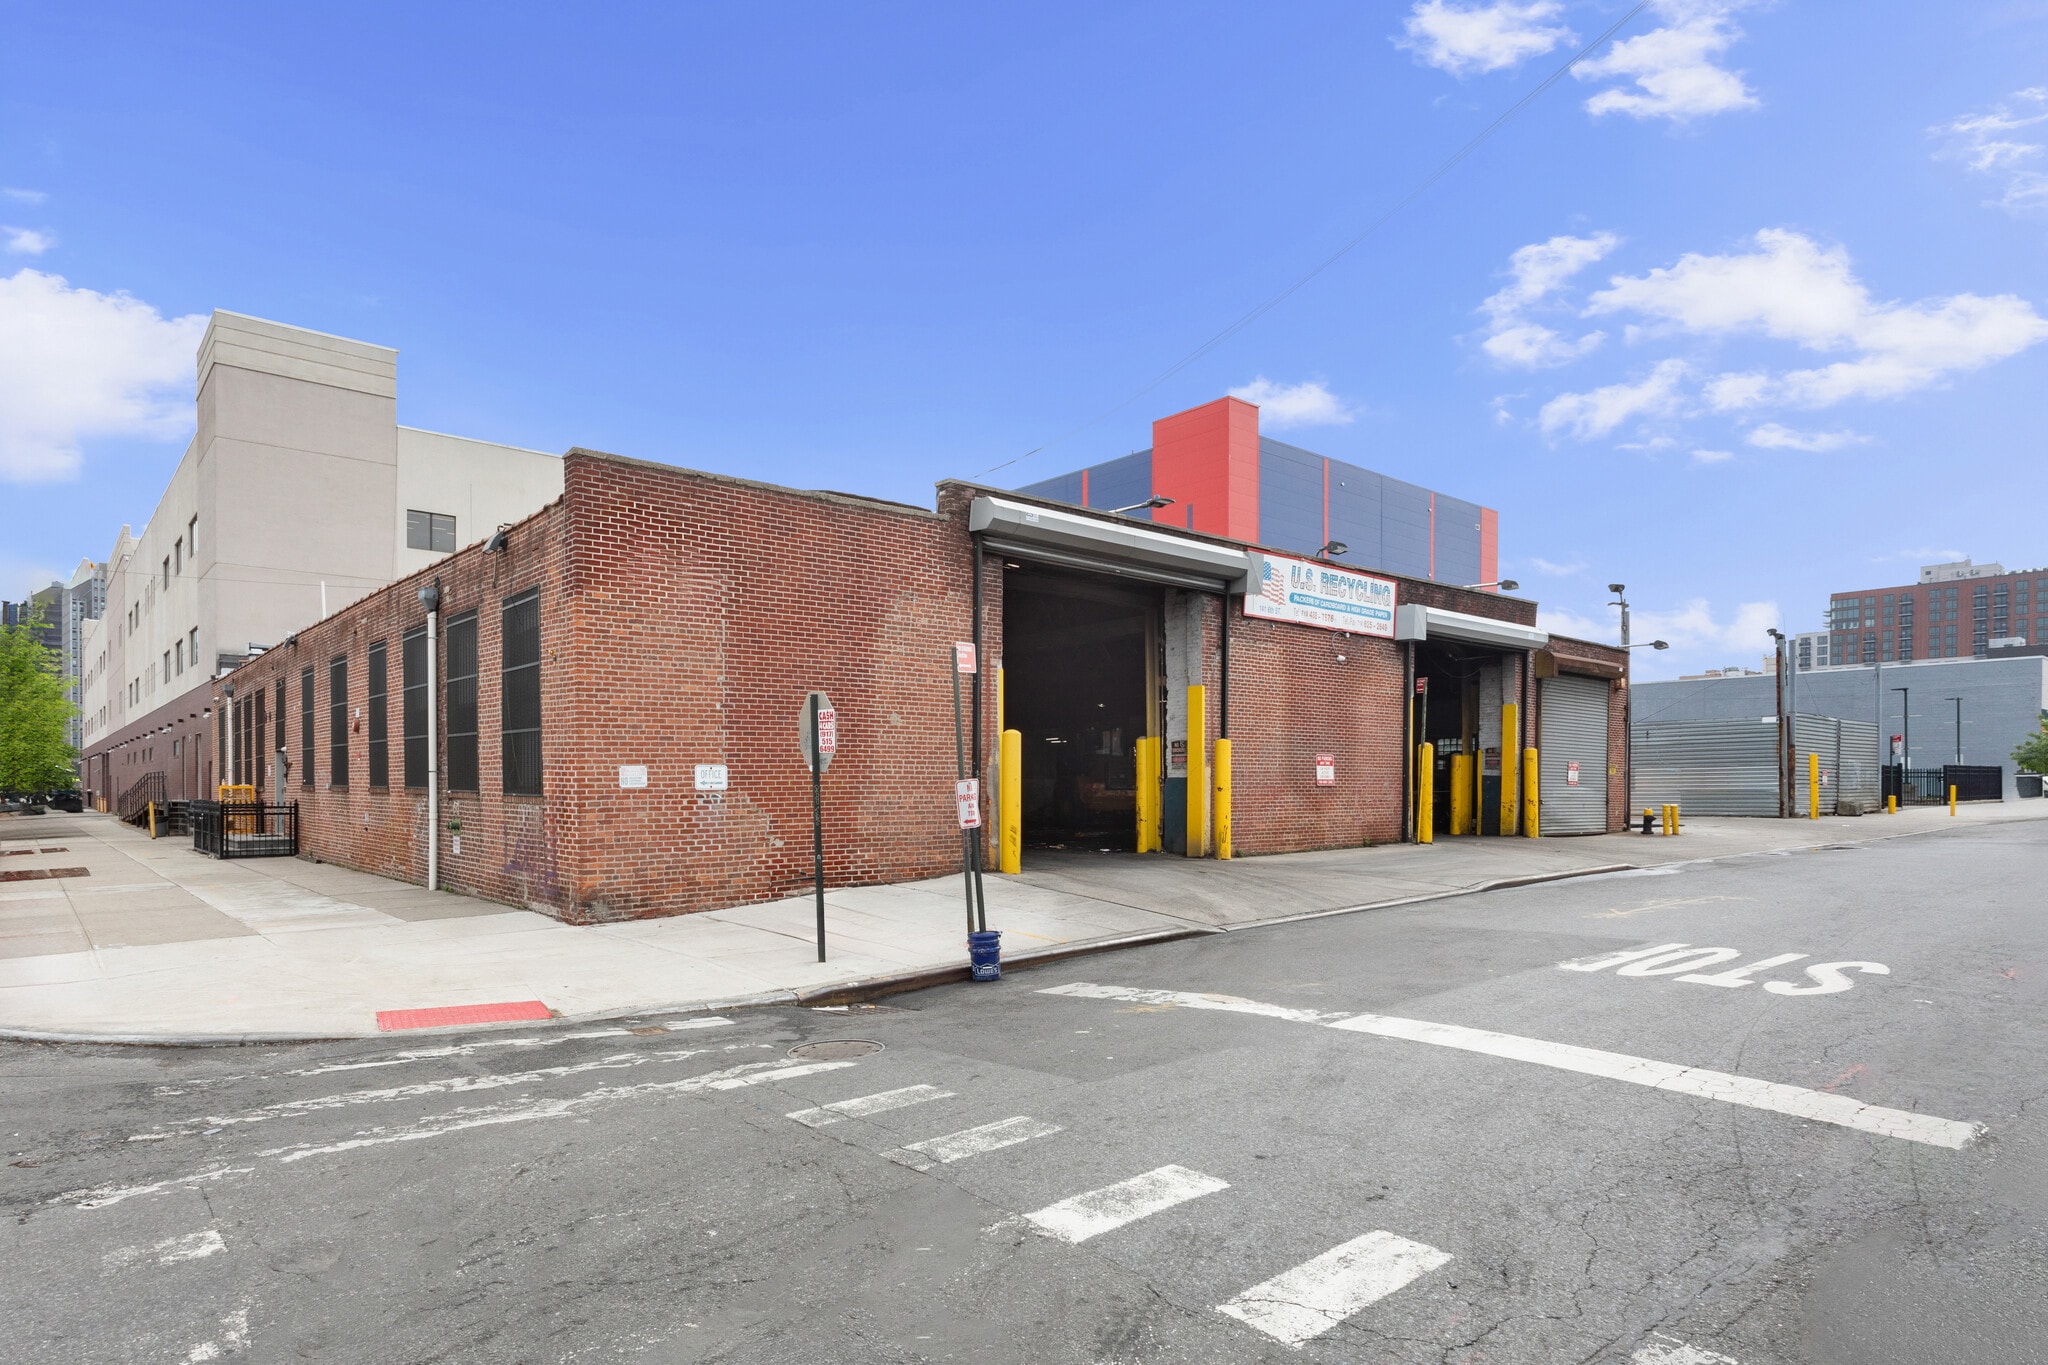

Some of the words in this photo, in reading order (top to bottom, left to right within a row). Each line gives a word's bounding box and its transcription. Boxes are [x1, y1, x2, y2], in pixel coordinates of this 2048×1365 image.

[1291, 565, 1316, 592] U.S.
[1320, 571, 1391, 607] RECYCLING
[820, 745, 835, 753] 6499
[700, 769, 722, 779] OFFICE
[1557, 942, 1891, 996] STOP
